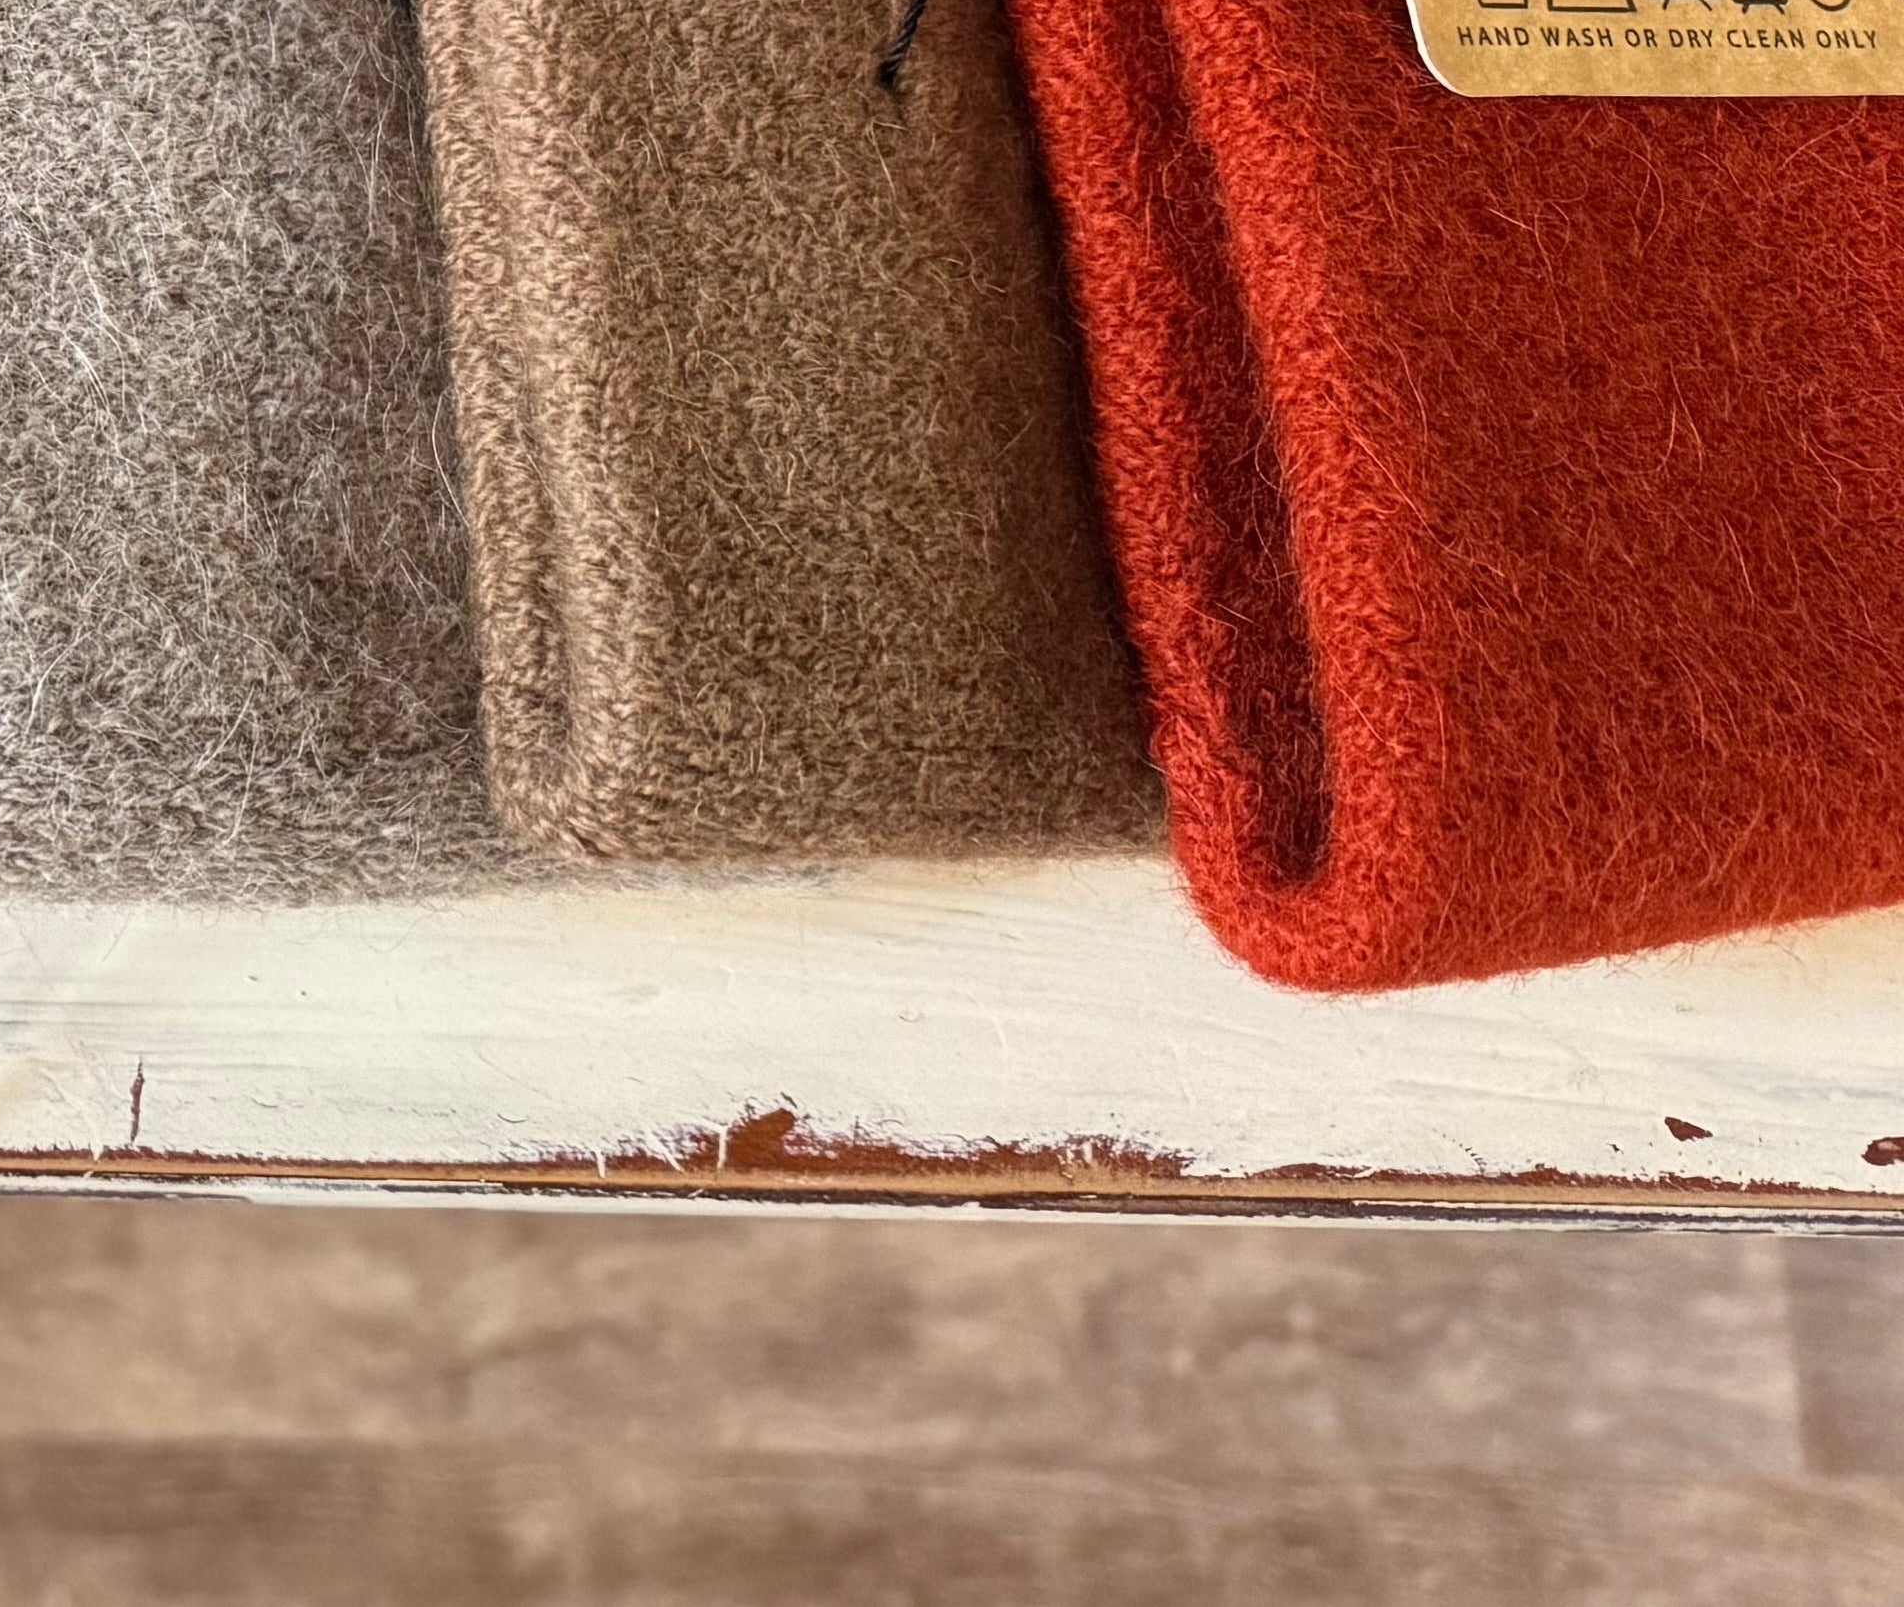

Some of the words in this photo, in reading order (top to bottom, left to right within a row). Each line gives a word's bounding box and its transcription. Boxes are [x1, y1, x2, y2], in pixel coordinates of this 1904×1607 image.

[1457, 25, 1530, 46] HAND
[1540, 26, 1613, 47] WASH
[1625, 28, 1658, 48] OR
[1669, 28, 1713, 48] DRY
[1726, 29, 1806, 49] CLEAN
[1816, 29, 1877, 49] ONLY
